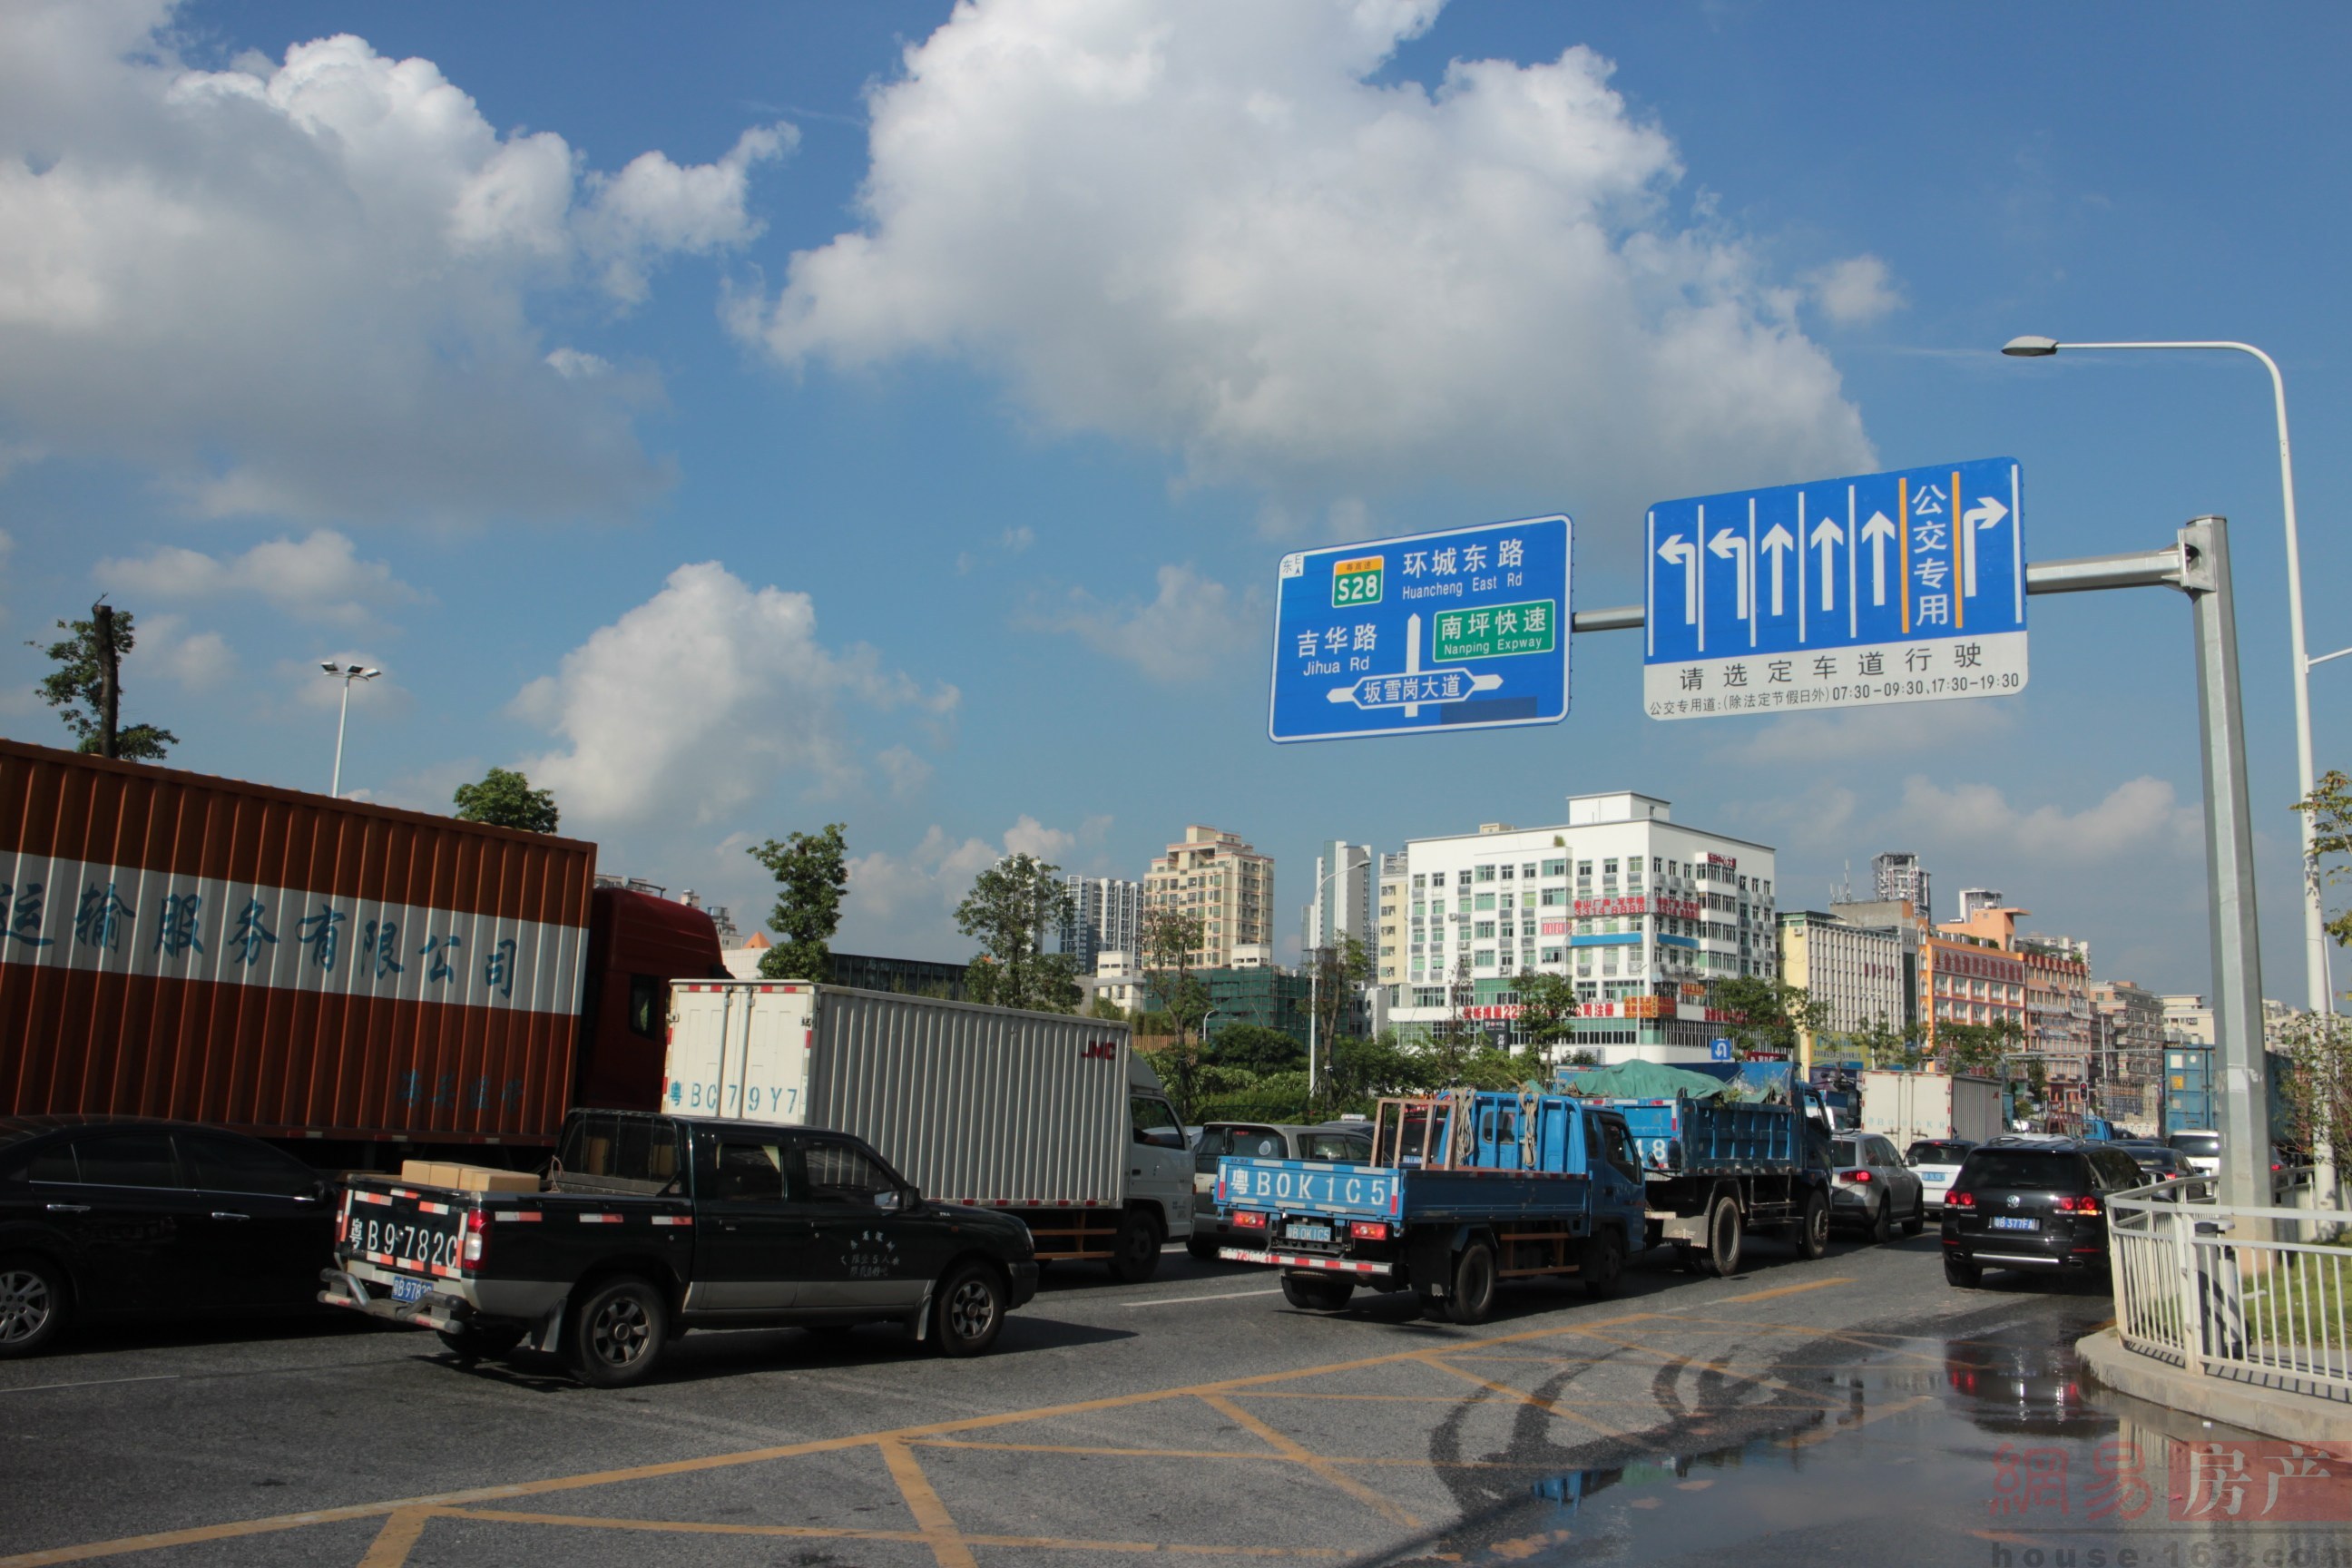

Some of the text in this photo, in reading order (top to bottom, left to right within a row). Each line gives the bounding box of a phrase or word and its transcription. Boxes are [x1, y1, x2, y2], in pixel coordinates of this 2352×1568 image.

[1282, 560, 1292, 574] 东
[1402, 538, 1524, 579] 环城东路
[1911, 484, 1949, 627] 公交专用
[1338, 574, 1378, 602] S28
[1402, 572, 1523, 601] Huancheng East Rd
[1441, 606, 1546, 641] 南坪快速
[1298, 622, 1377, 658] 吉华路
[1444, 636, 1542, 656] Nanping Expway
[1303, 656, 1369, 677] Jihua Rd
[1680, 642, 1983, 691] 请选定车道行驶
[1364, 674, 1461, 704] 坂雪岗大道
[1574, 905, 1645, 916] 3314 8888
[0, 883, 517, 998] 运输服务有限公司
[1081, 1041, 1116, 1061] JMC
